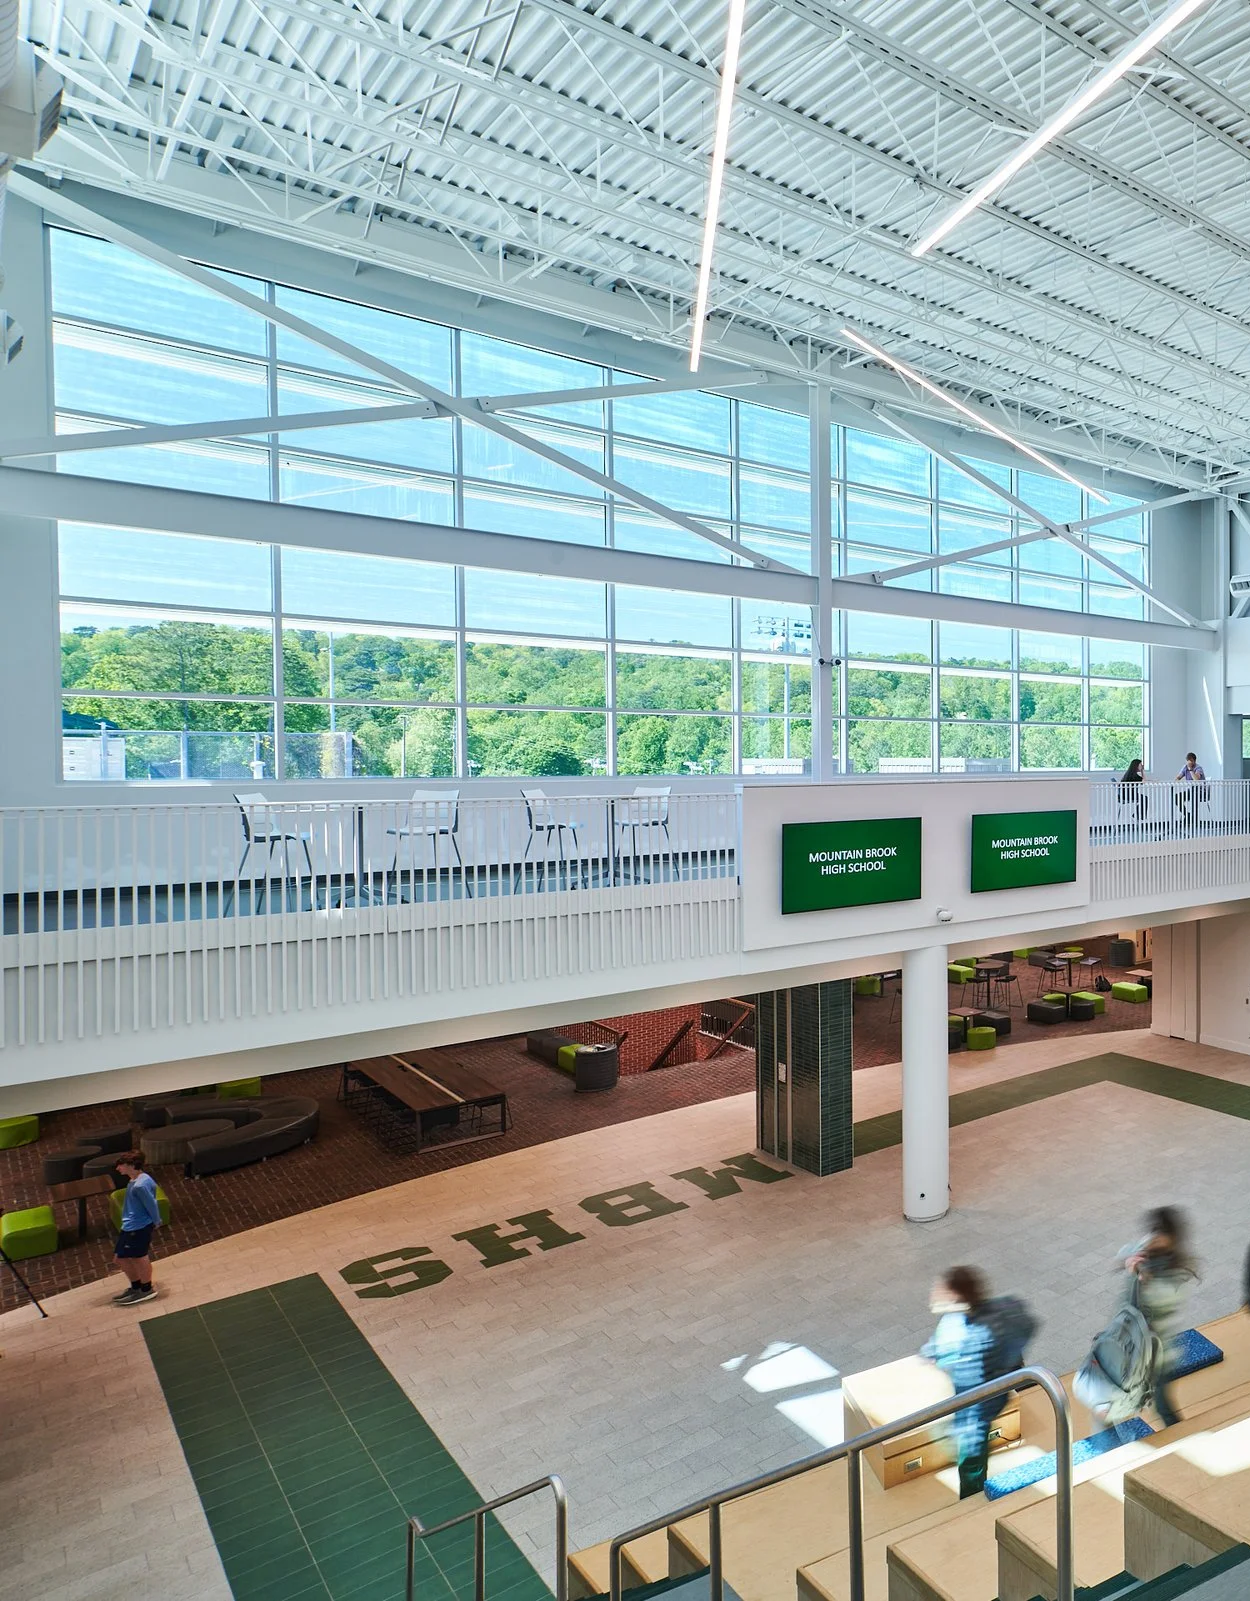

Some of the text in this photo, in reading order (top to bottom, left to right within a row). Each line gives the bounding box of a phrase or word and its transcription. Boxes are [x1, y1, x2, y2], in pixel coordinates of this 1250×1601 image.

[991, 835, 1059, 849] MOUNTAIN BROOK
[808, 846, 898, 863] MOUNTAIN BROOK
[1000, 847, 1050, 860] HIGH SCHOOL
[821, 860, 887, 876] HIGH SCHOOL
[338, 1152, 796, 1299] MBHS
